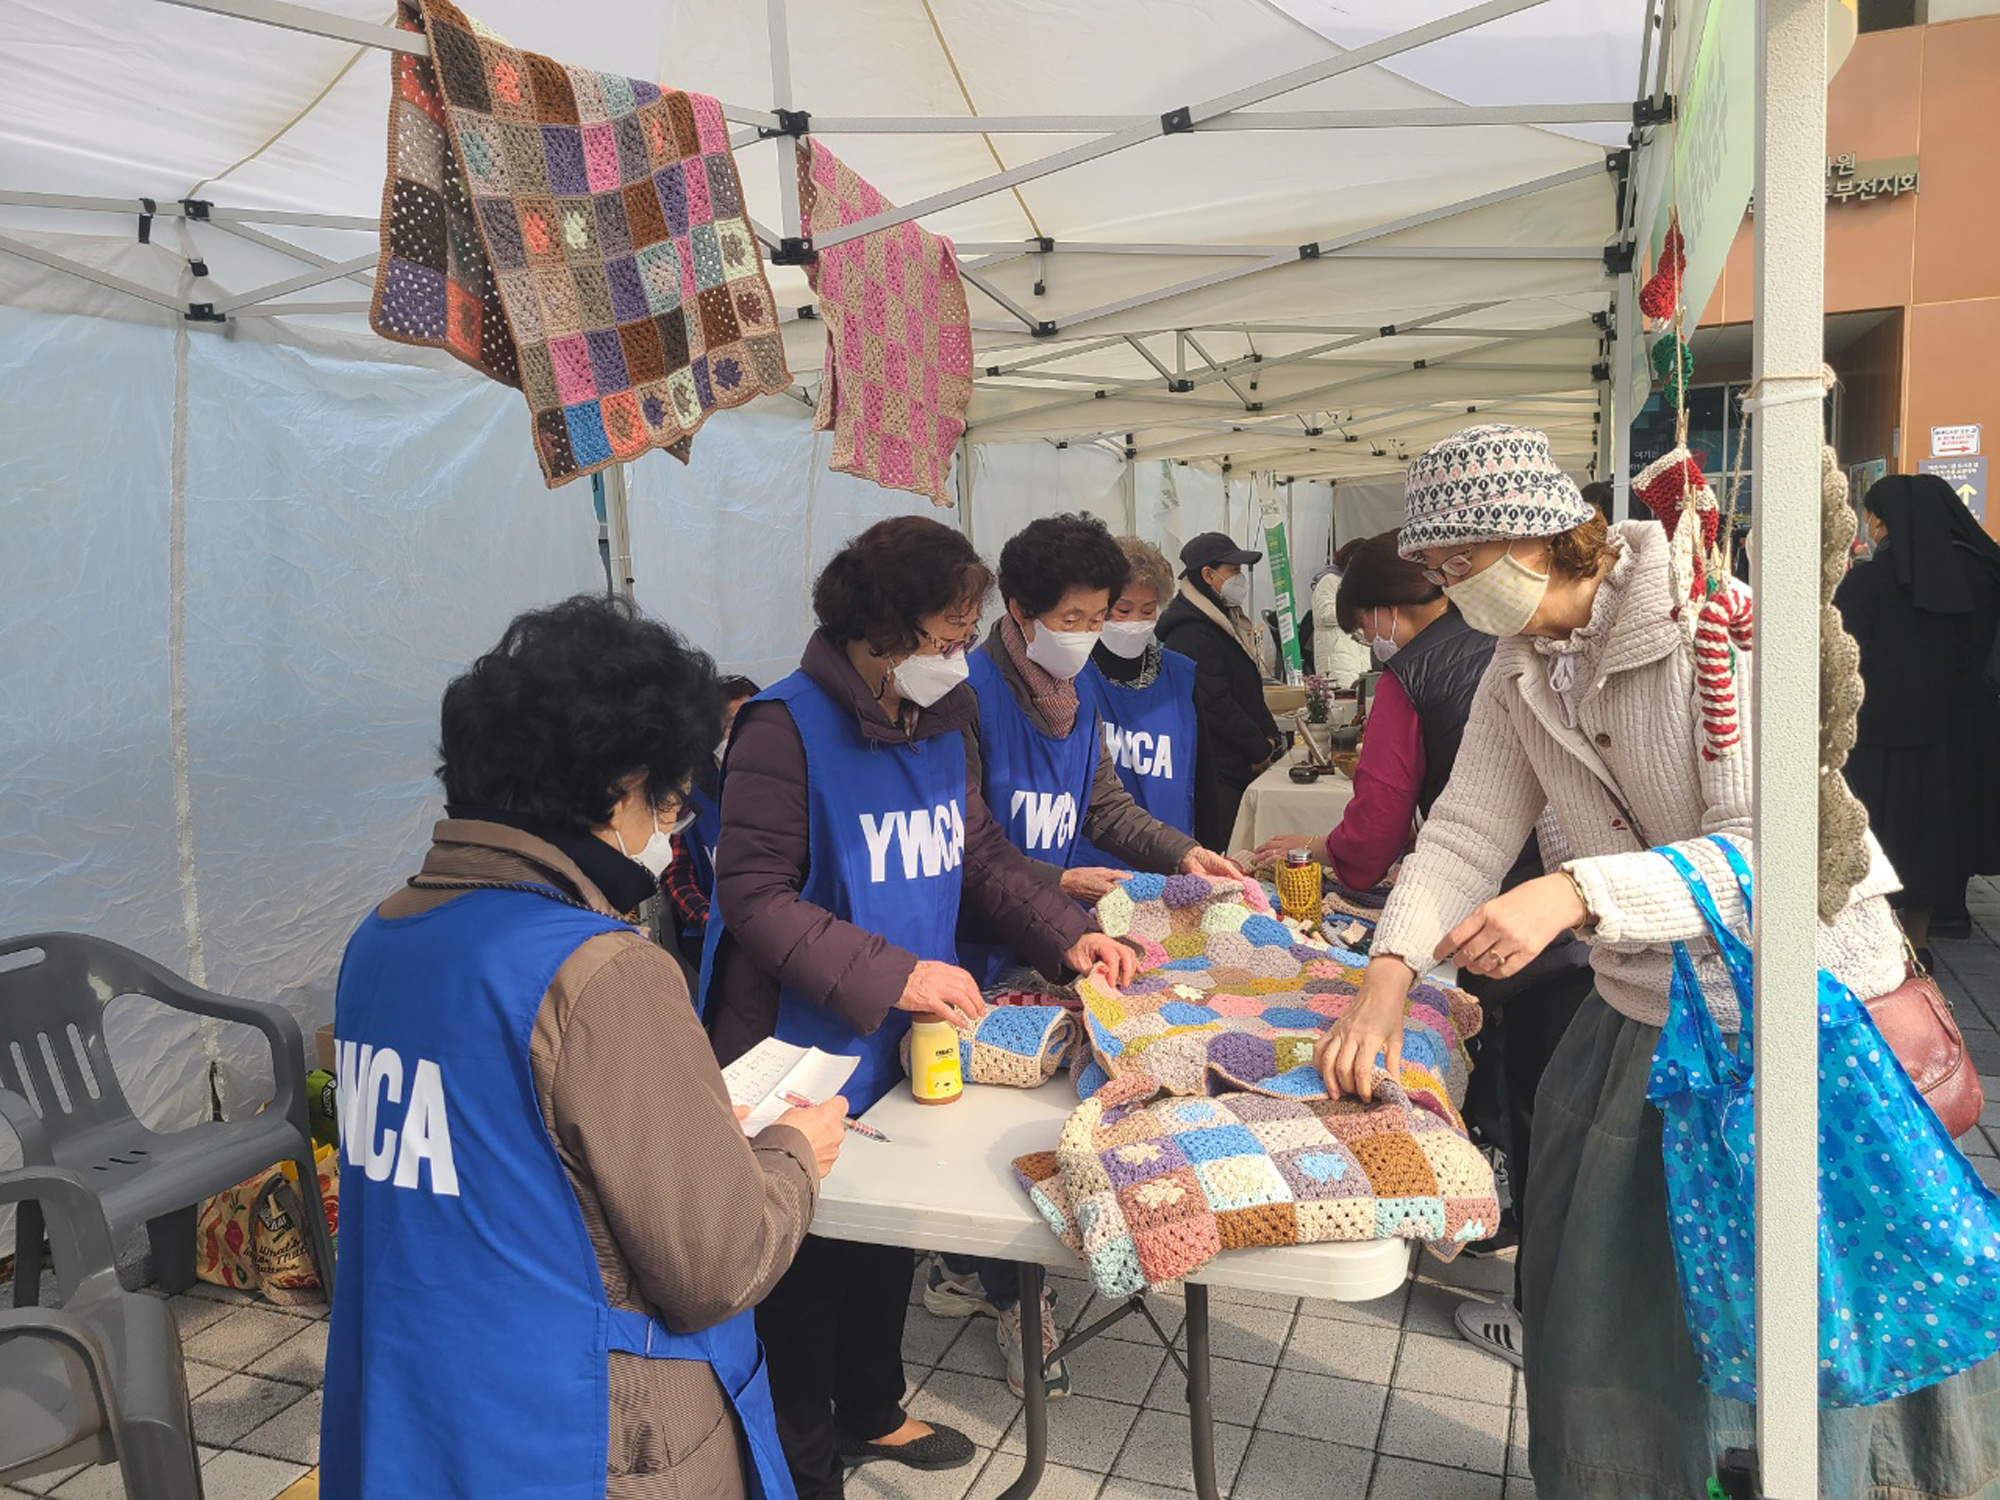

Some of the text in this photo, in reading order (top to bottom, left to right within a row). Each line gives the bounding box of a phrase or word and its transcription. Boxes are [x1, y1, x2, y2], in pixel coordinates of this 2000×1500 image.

[1103, 721, 1173, 779] WCA
[859, 799, 965, 883] YWCA
[334, 1038, 460, 1197] WCA
